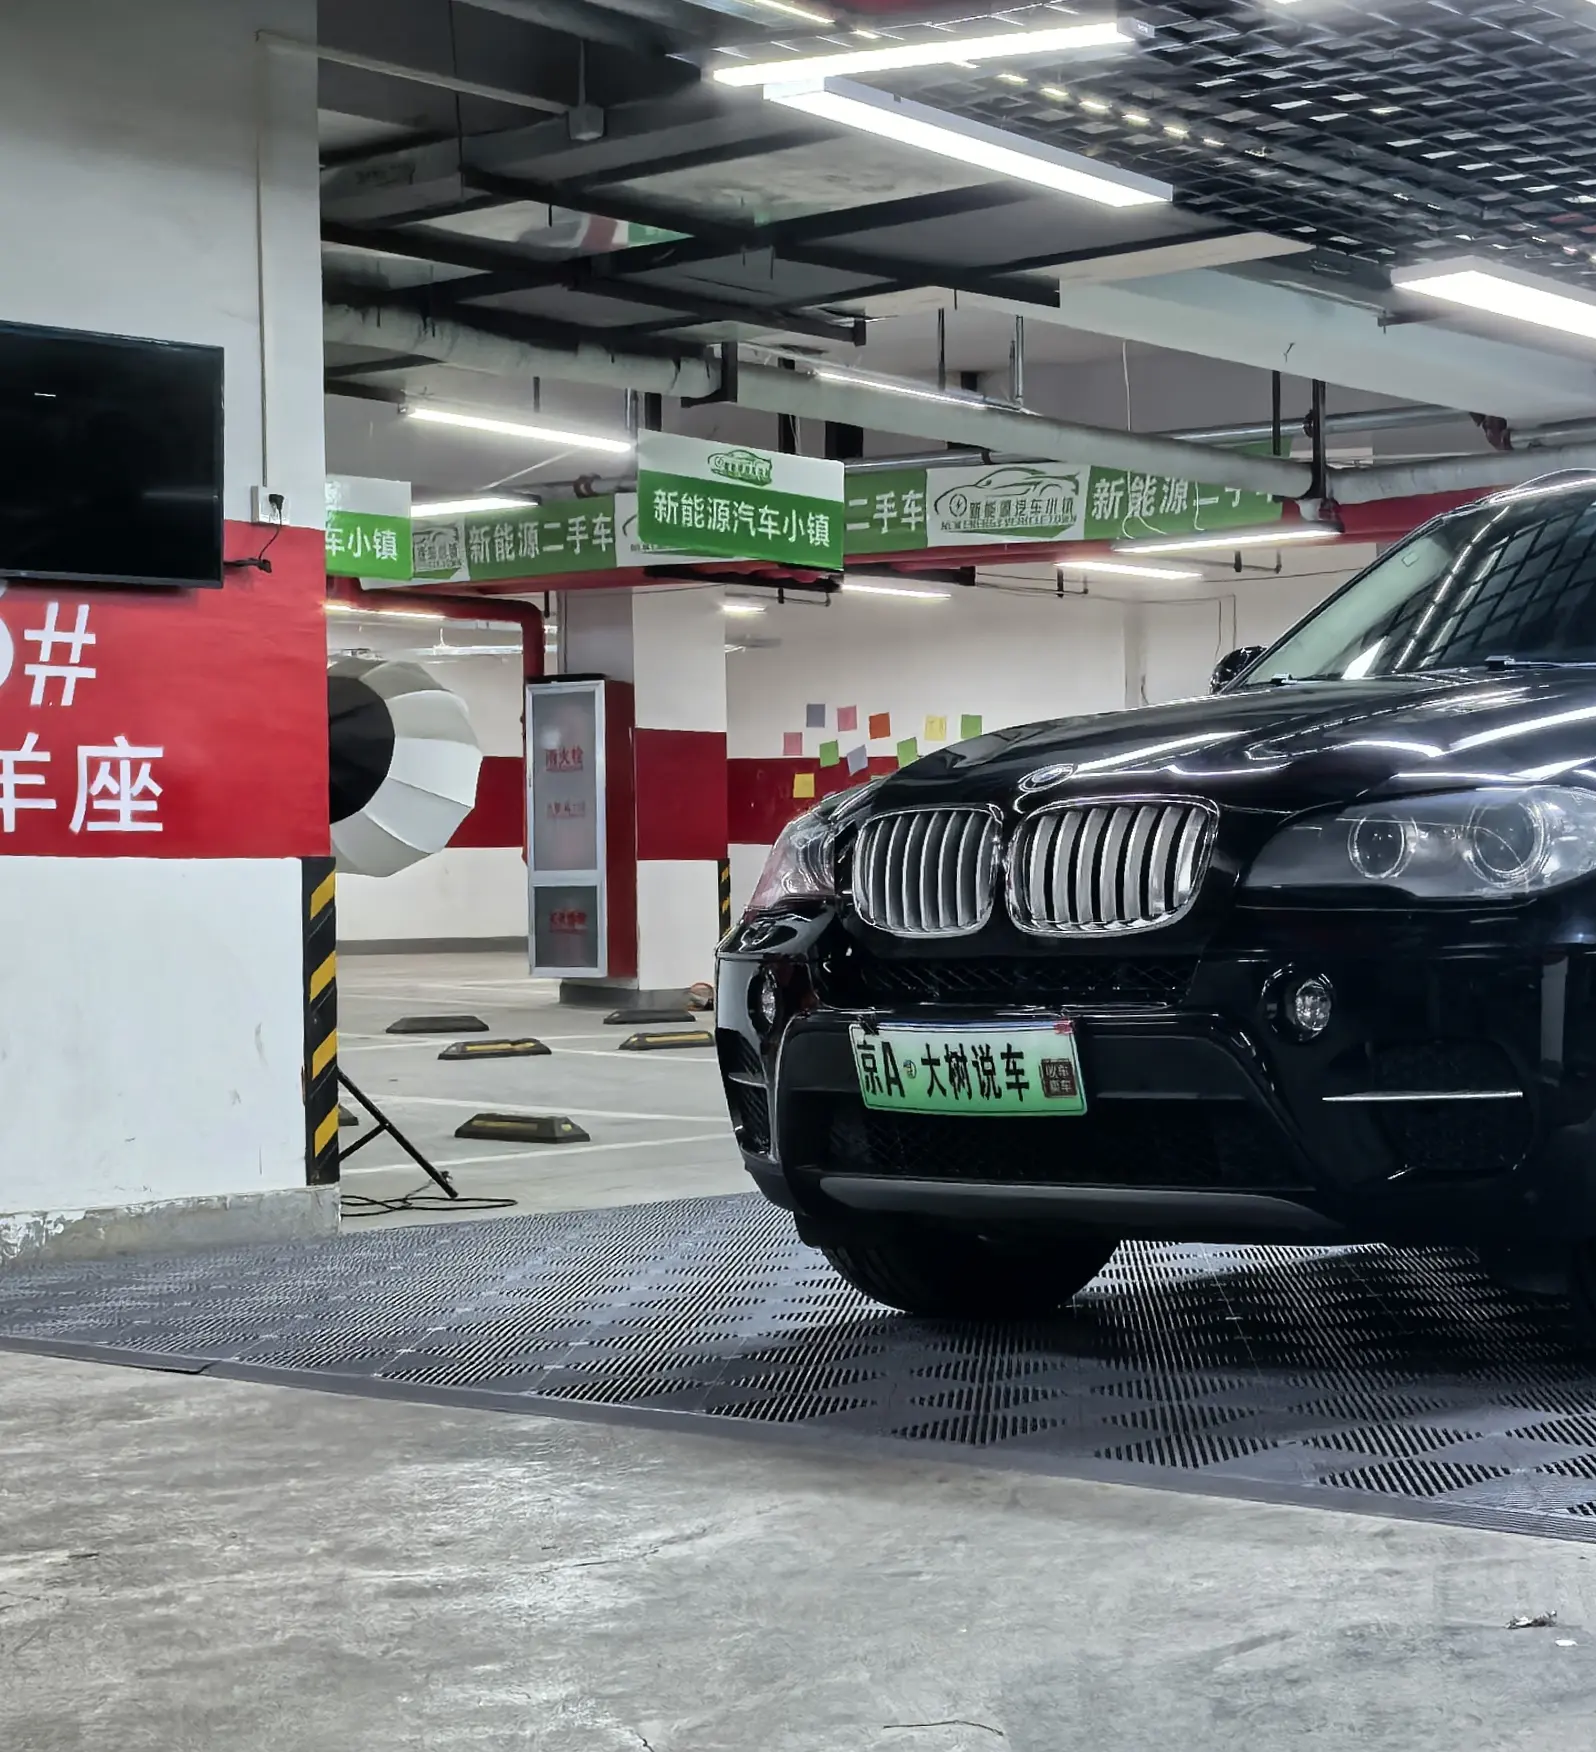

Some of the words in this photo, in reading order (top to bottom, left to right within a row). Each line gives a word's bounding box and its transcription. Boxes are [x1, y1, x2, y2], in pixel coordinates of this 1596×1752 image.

[653, 488, 830, 548] 新能源汽车小镇
[846, 490, 924, 534] 二手车
[1092, 476, 1273, 520] 新能源
[468, 512, 614, 564] 新能源二手车
[857, 1040, 905, 1098] 京A
[921, 1043, 1030, 1102] 大树说车
